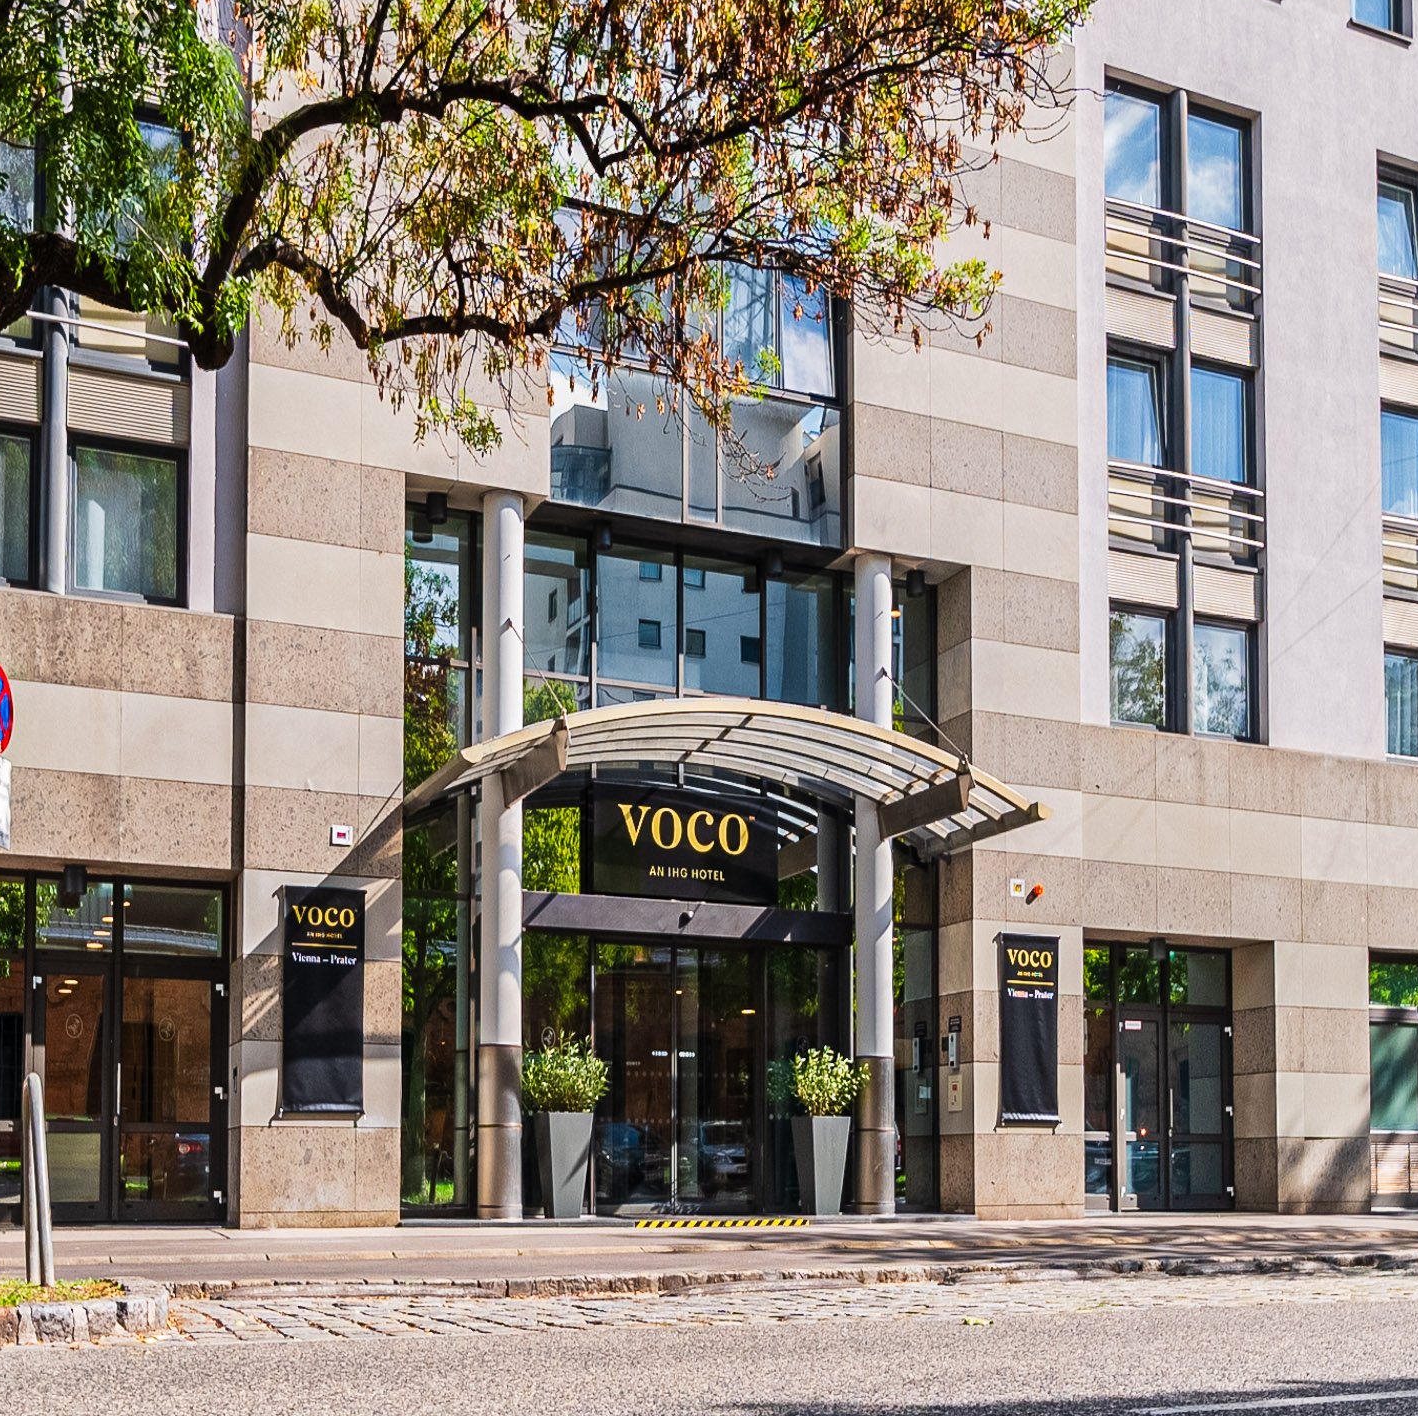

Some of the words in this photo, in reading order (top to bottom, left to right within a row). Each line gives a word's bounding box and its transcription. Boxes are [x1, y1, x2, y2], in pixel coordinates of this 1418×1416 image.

[649, 865, 664, 877] AN
[668, 866, 688, 878] IHG
[691, 868, 725, 881] HOTEL
[292, 951, 321, 963] Vienna
[330, 954, 357, 965] Prater
